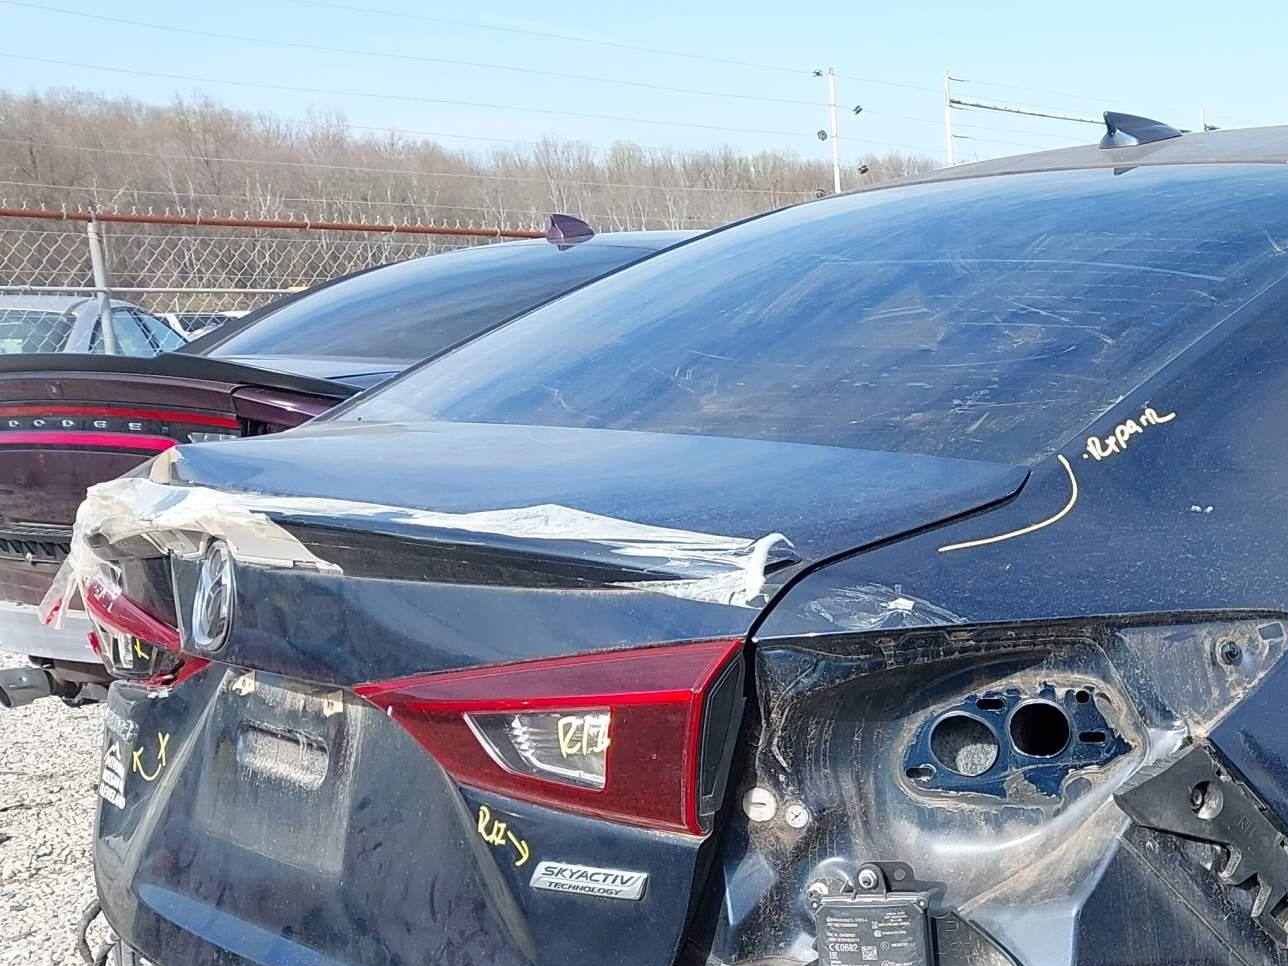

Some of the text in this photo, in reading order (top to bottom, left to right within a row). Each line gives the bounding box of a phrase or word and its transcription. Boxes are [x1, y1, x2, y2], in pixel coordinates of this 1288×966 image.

[8, 419, 142, 431] DODGE
[541, 866, 635, 885] SKYACTIV
[547, 881, 623, 896] TECHNOLOGY
